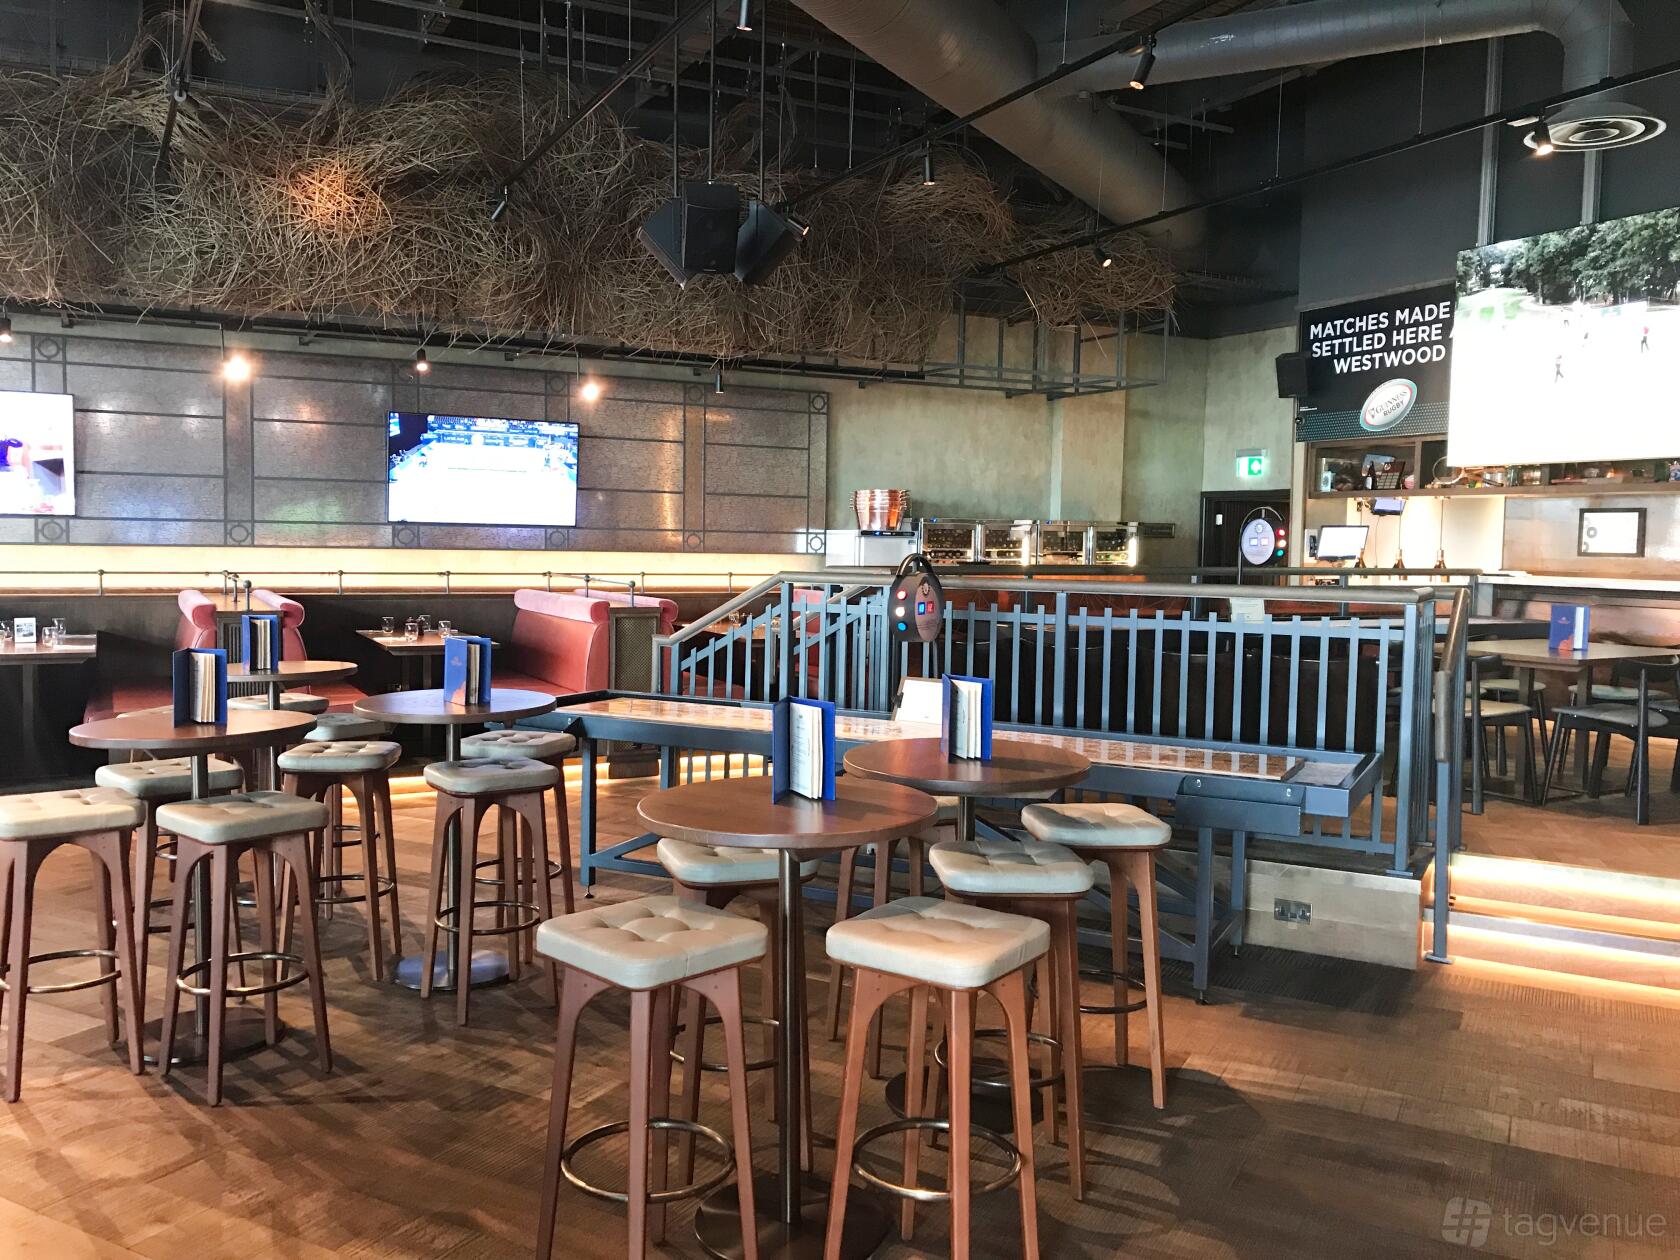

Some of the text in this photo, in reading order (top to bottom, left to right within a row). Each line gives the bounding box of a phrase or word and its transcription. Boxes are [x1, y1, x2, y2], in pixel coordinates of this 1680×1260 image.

[1310, 301, 1451, 340] MATCHES MADE
[1312, 332, 1386, 358] SETTLED
[1392, 323, 1443, 347] HERE
[1334, 344, 1446, 375] WESTWOOD
[1383, 399, 1405, 417] RUGBY
